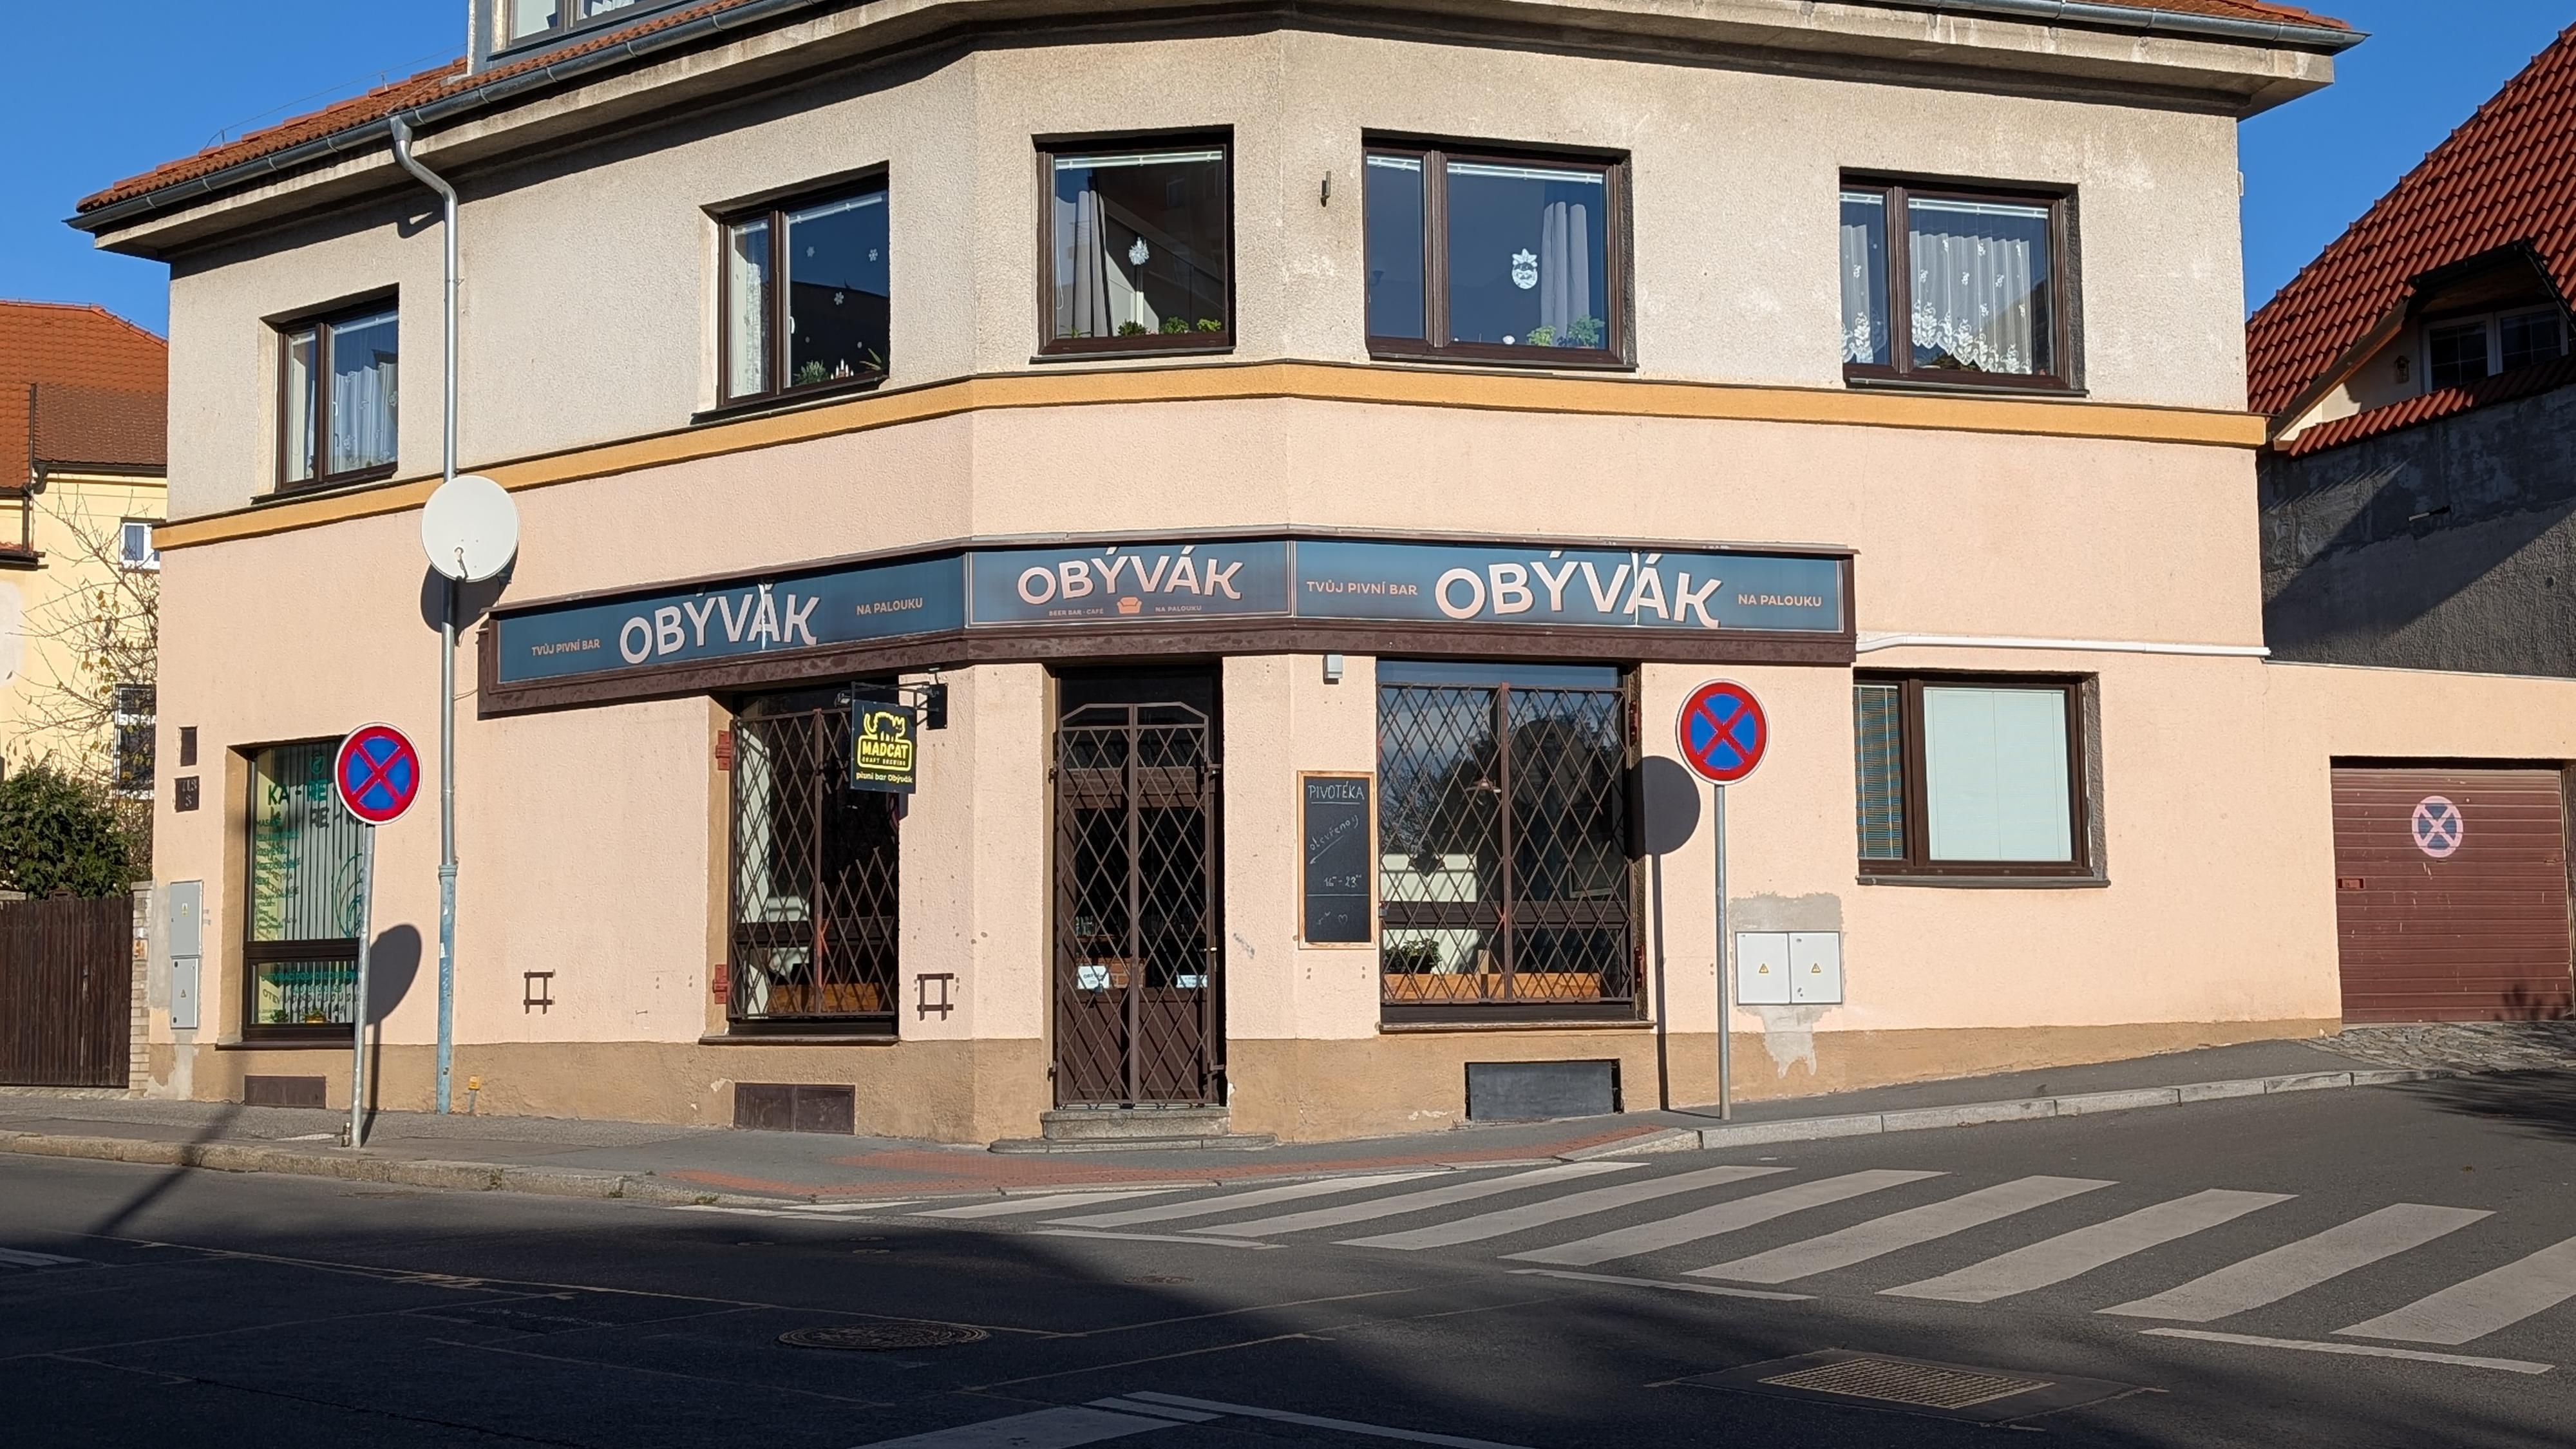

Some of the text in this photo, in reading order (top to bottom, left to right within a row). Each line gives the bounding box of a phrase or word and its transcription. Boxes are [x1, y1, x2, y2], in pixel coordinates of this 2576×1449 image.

[1018, 545, 1244, 605] OBÝVÁK
[1306, 580, 1418, 596] TVŮJ PIVNÍ BAR
[1435, 551, 1722, 629] OBÝVÁK
[857, 597, 923, 616] NA PALOUKU
[1738, 594, 1822, 607] NA PALOUKU
[620, 583, 821, 665] OBÝVÁK
[531, 639, 601, 656] TVŮJ PIVNÍ BAR
[862, 741, 909, 759] MADCAT
[1308, 781, 1365, 800] PIVOTÉKA
